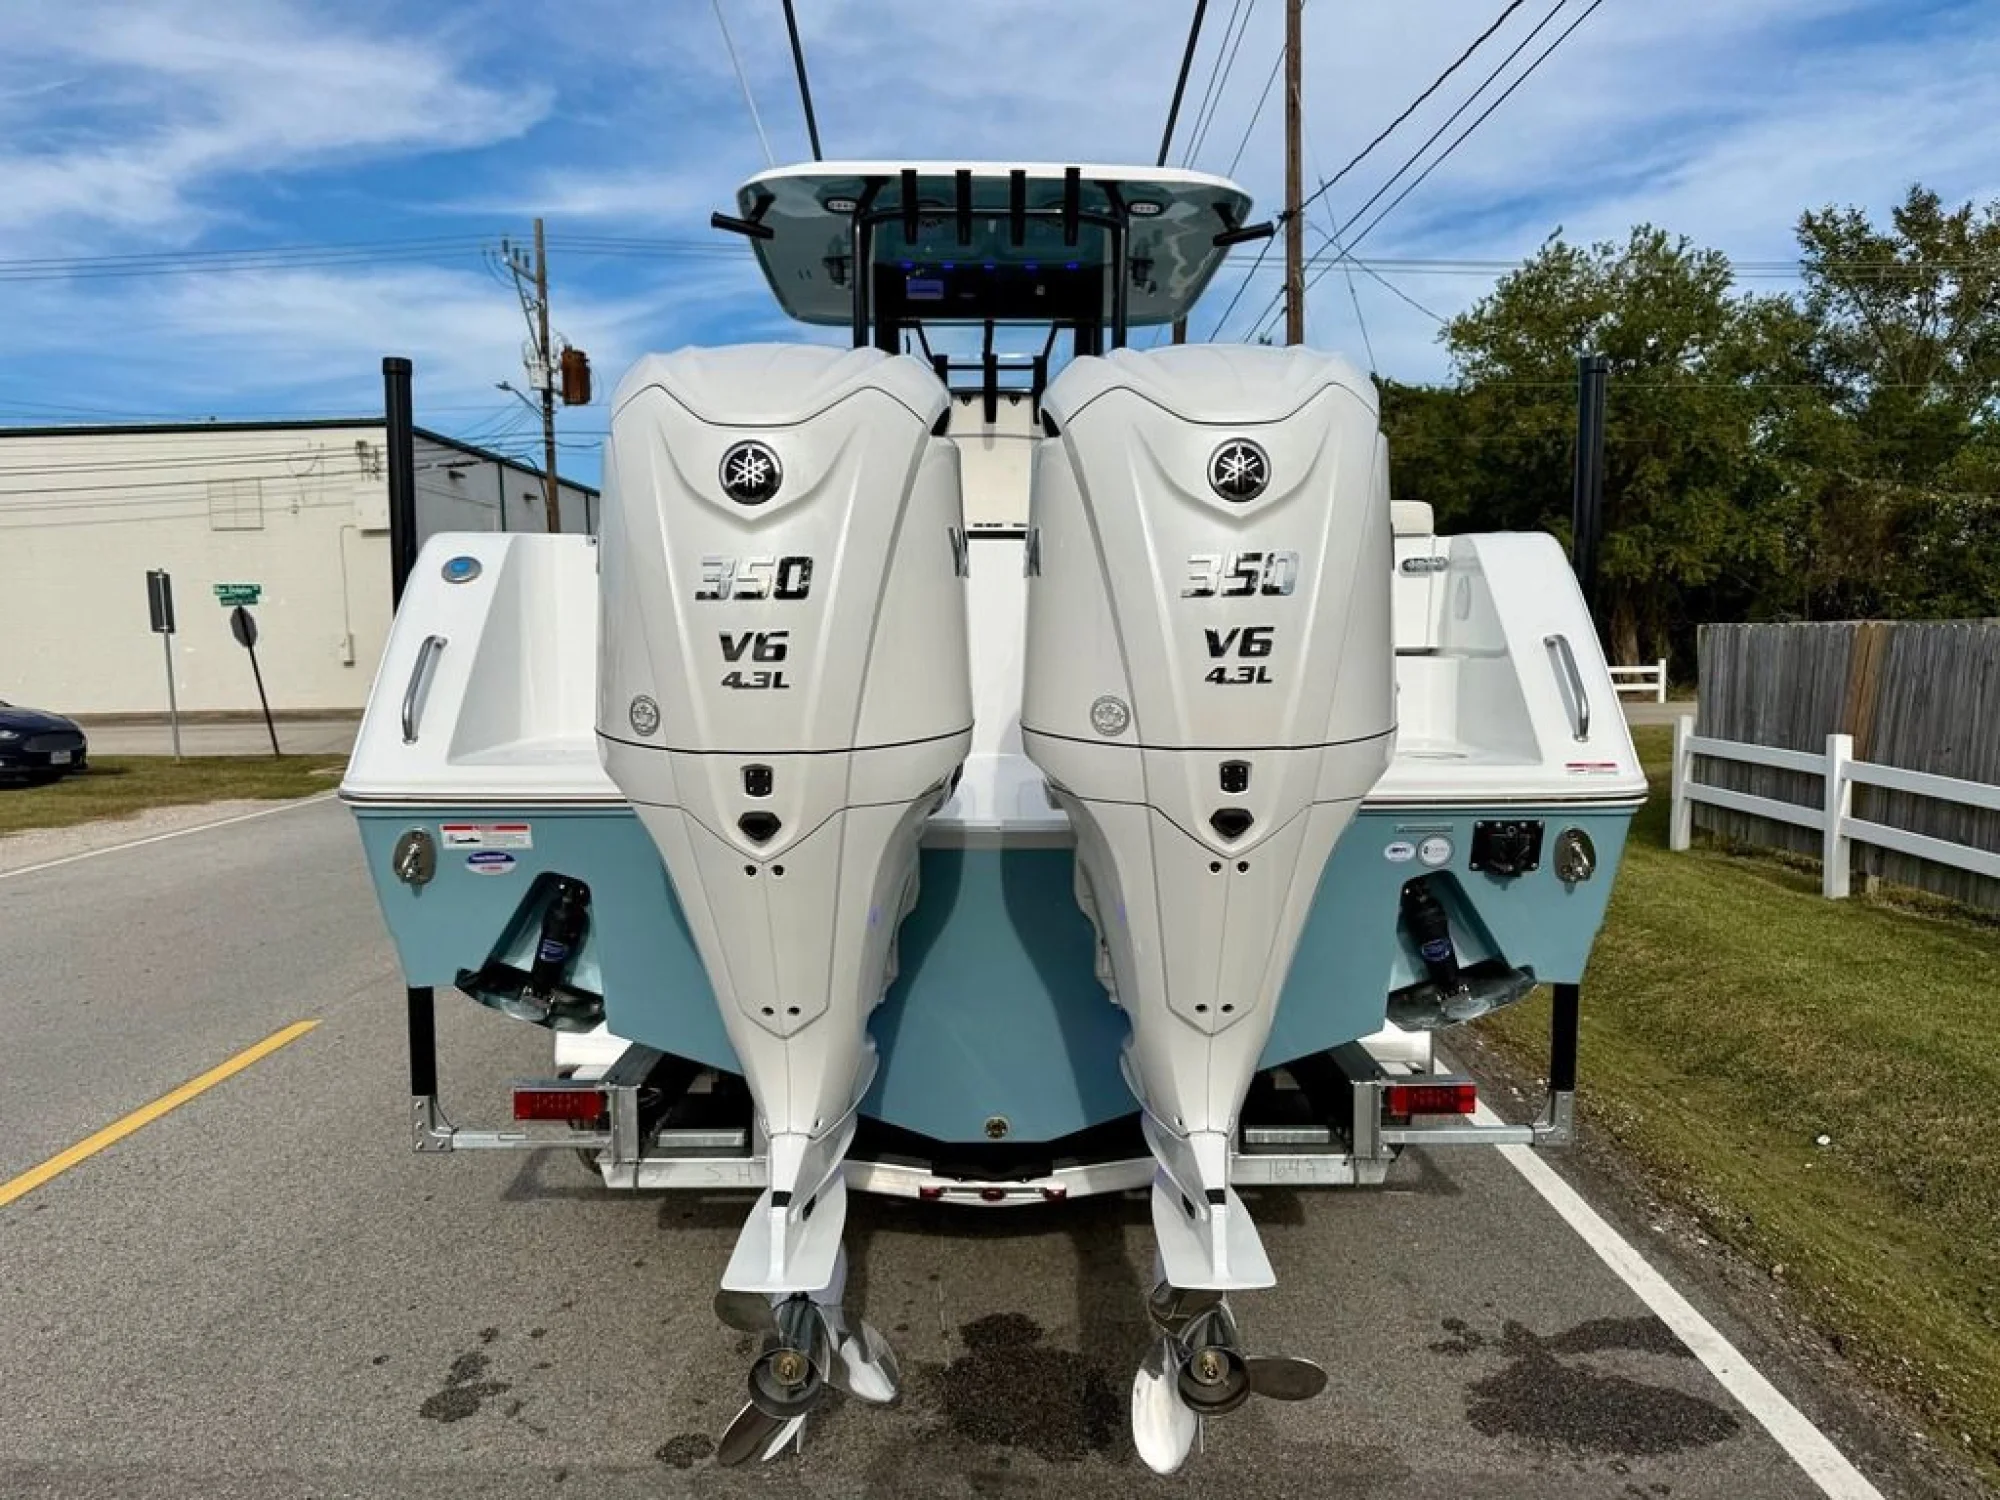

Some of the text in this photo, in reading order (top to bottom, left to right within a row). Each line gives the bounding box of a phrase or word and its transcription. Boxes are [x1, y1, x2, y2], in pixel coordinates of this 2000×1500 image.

[695, 556, 813, 600] 350
[1180, 552, 1299, 598] 350
[719, 631, 789, 662] V6
[1204, 626, 1274, 657] V6
[721, 671, 790, 688] 4.3L
[1204, 666, 1273, 684] 4.3L
